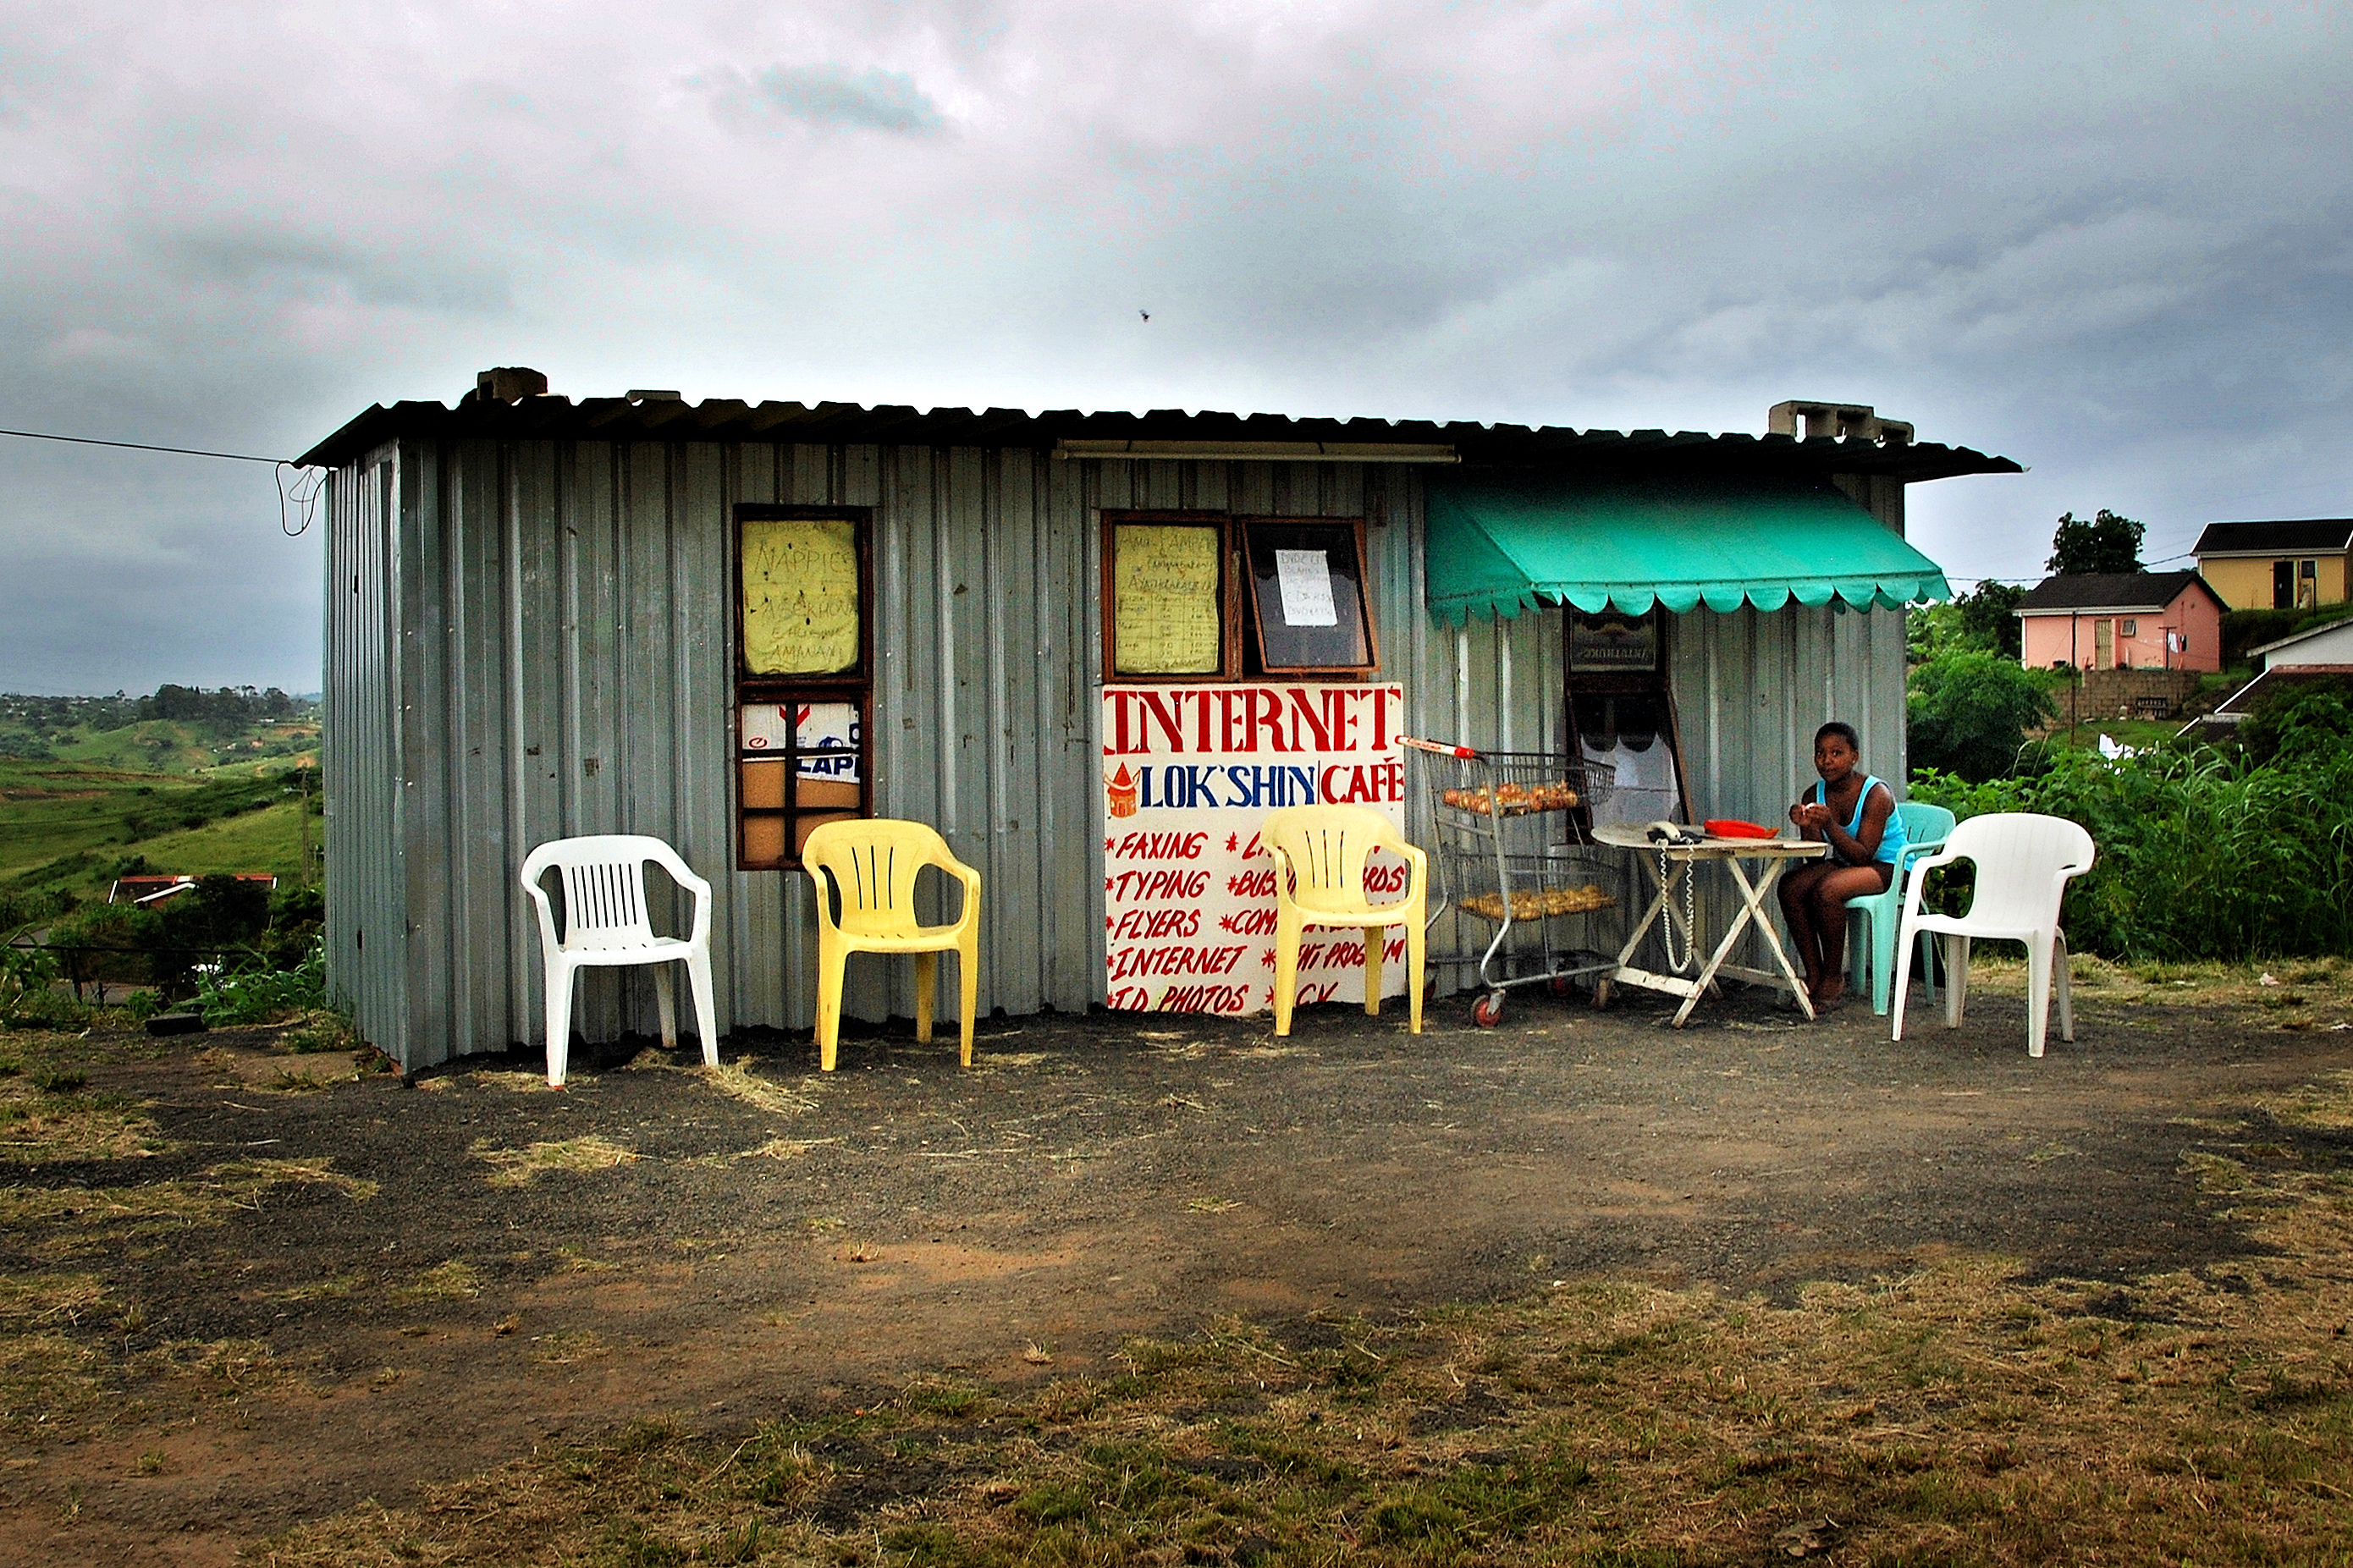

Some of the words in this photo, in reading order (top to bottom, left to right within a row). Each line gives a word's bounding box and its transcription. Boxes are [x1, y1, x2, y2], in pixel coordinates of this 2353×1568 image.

[1103, 688, 1401, 755] INTERNET
[1140, 765, 1315, 807] LOK'SHIN
[1321, 756, 1405, 805] CAFÉ
[1116, 831, 1208, 861] FAXING
[1116, 869, 1211, 902] TYPING
[1114, 909, 1201, 941] FLYERS
[1111, 945, 1247, 982] INTERNET
[1323, 938, 1405, 970] PROGM
[1158, 984, 1250, 1014] PHOTOS
